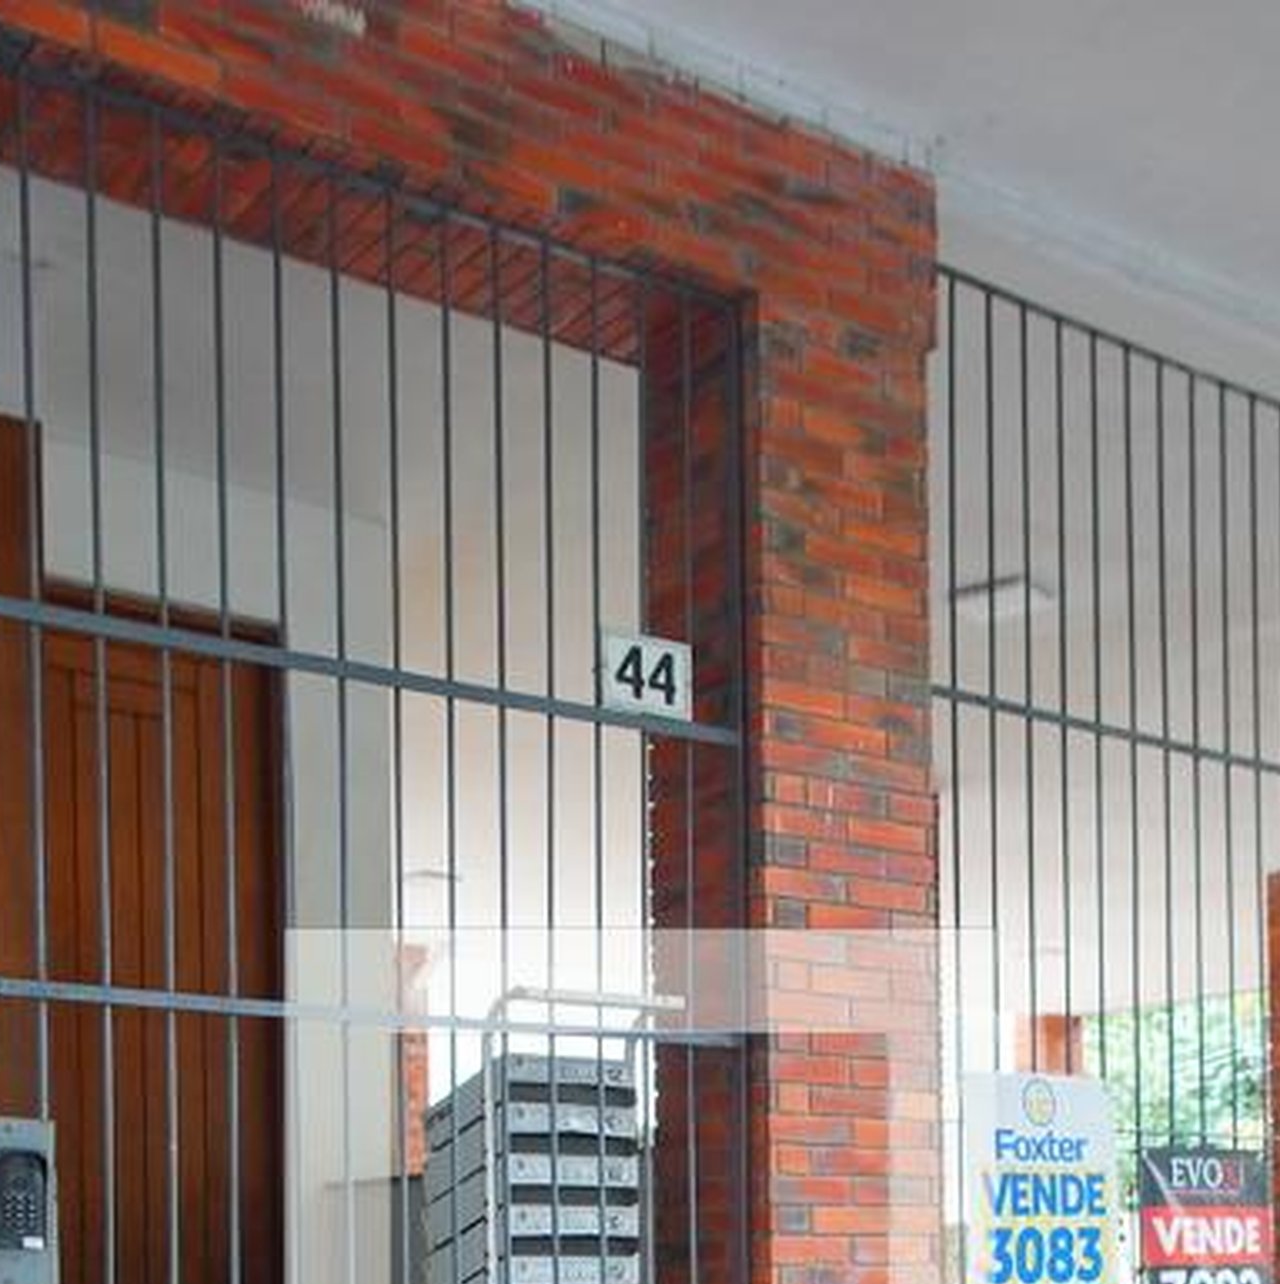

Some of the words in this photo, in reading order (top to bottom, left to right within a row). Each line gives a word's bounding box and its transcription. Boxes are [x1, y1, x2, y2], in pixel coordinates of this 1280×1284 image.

[615, 646, 676, 705] 44
[994, 1128, 1088, 1161] Foxter
[986, 1172, 1107, 1217] VENDE
[987, 1226, 1103, 1284] 3083
[1153, 1215, 1261, 1256] VENDE
